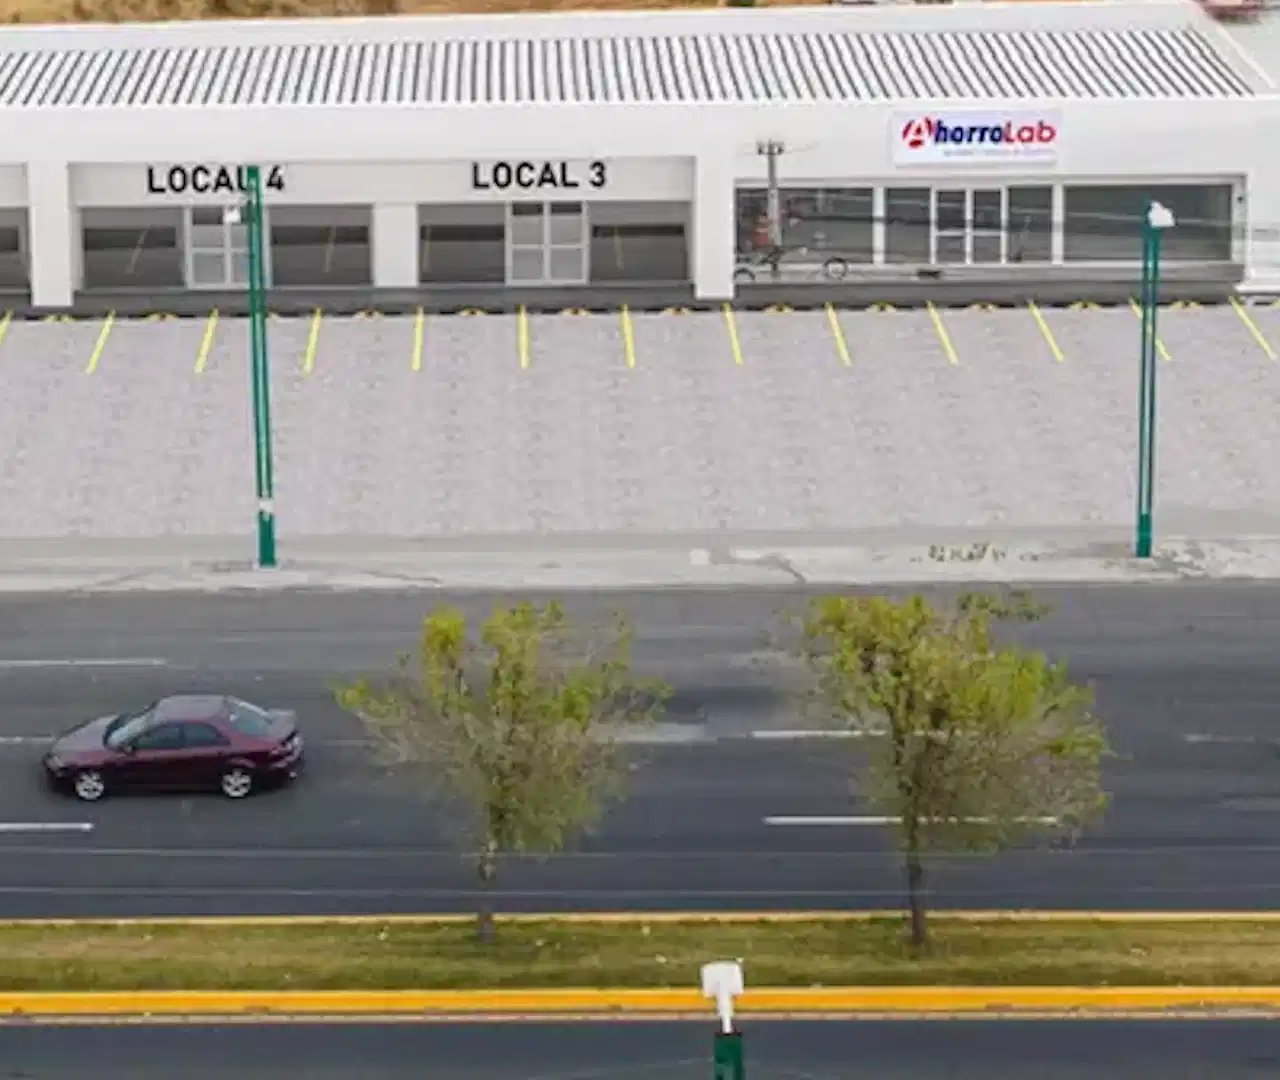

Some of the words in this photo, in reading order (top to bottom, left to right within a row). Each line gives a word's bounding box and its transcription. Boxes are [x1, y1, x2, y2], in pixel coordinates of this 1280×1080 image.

[902, 115, 1057, 149] AhorroLab
[146, 166, 251, 195] LOCAL
[266, 165, 285, 191] 4
[472, 161, 579, 189] LOCAL
[589, 161, 606, 188] 3
